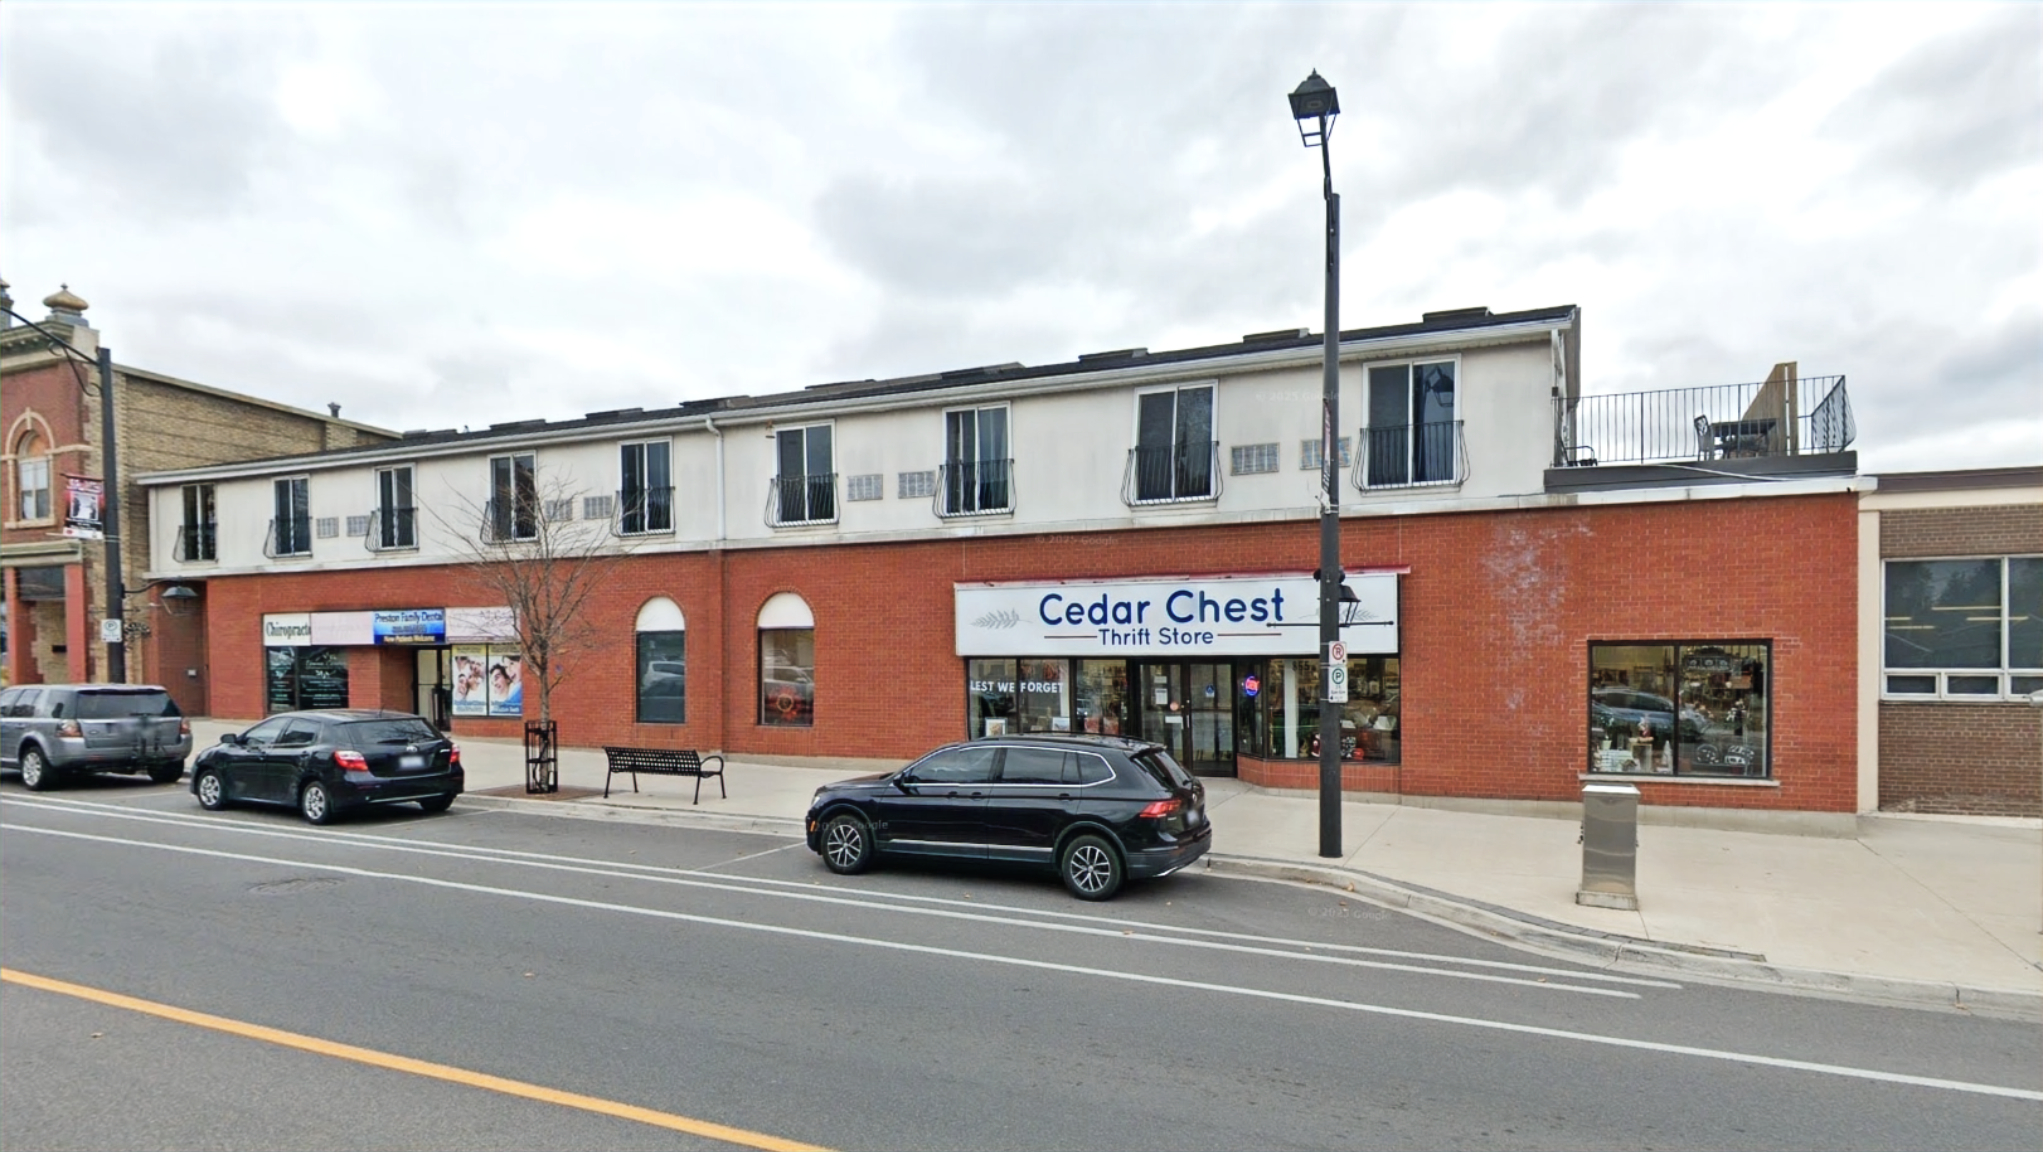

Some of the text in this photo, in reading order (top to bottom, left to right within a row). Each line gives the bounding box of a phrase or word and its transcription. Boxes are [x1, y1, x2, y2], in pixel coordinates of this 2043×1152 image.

[1039, 587, 1284, 625] Cedar Chest
[1098, 627, 1214, 645] Thrift Store
[970, 681, 1063, 694] LEST WE FORGET
